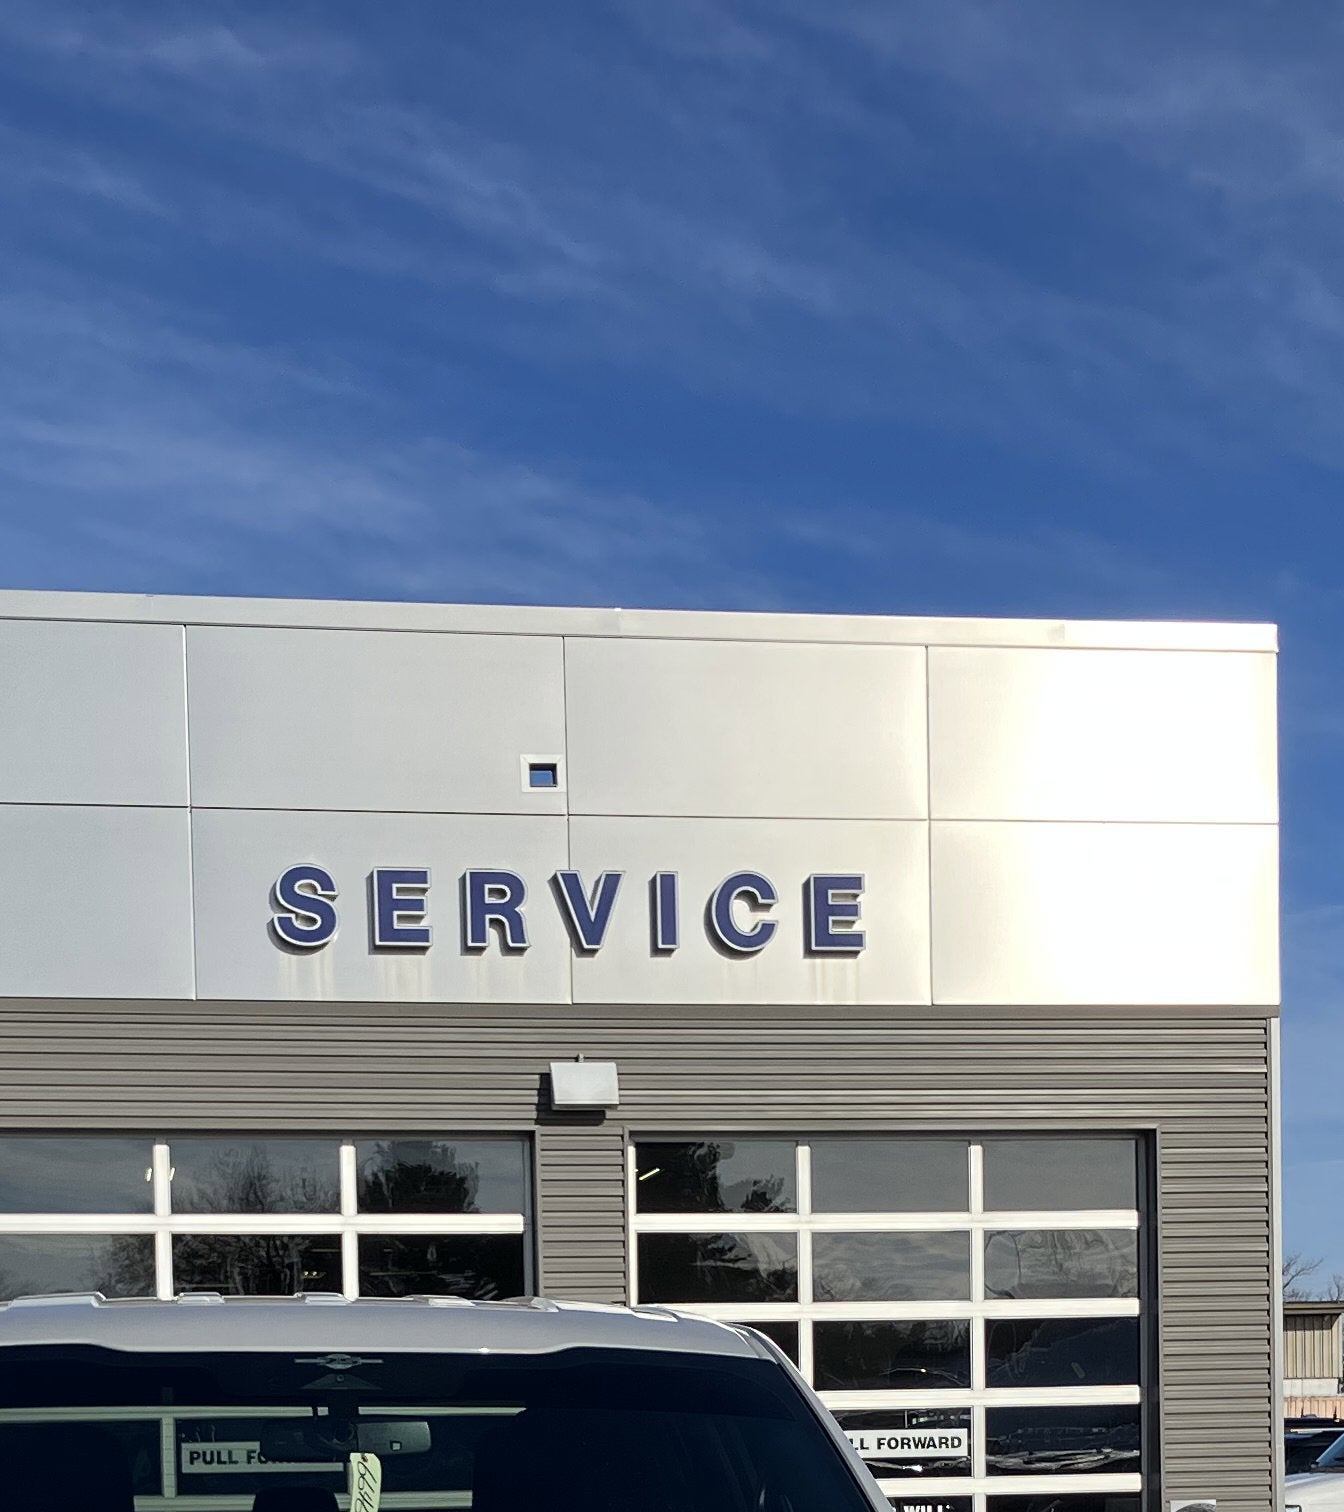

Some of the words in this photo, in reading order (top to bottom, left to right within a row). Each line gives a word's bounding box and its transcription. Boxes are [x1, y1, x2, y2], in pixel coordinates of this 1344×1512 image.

[268, 862, 867, 957] SERVICE
[876, 1436, 962, 1450] FORWARD
[189, 1450, 239, 1465] PULL
